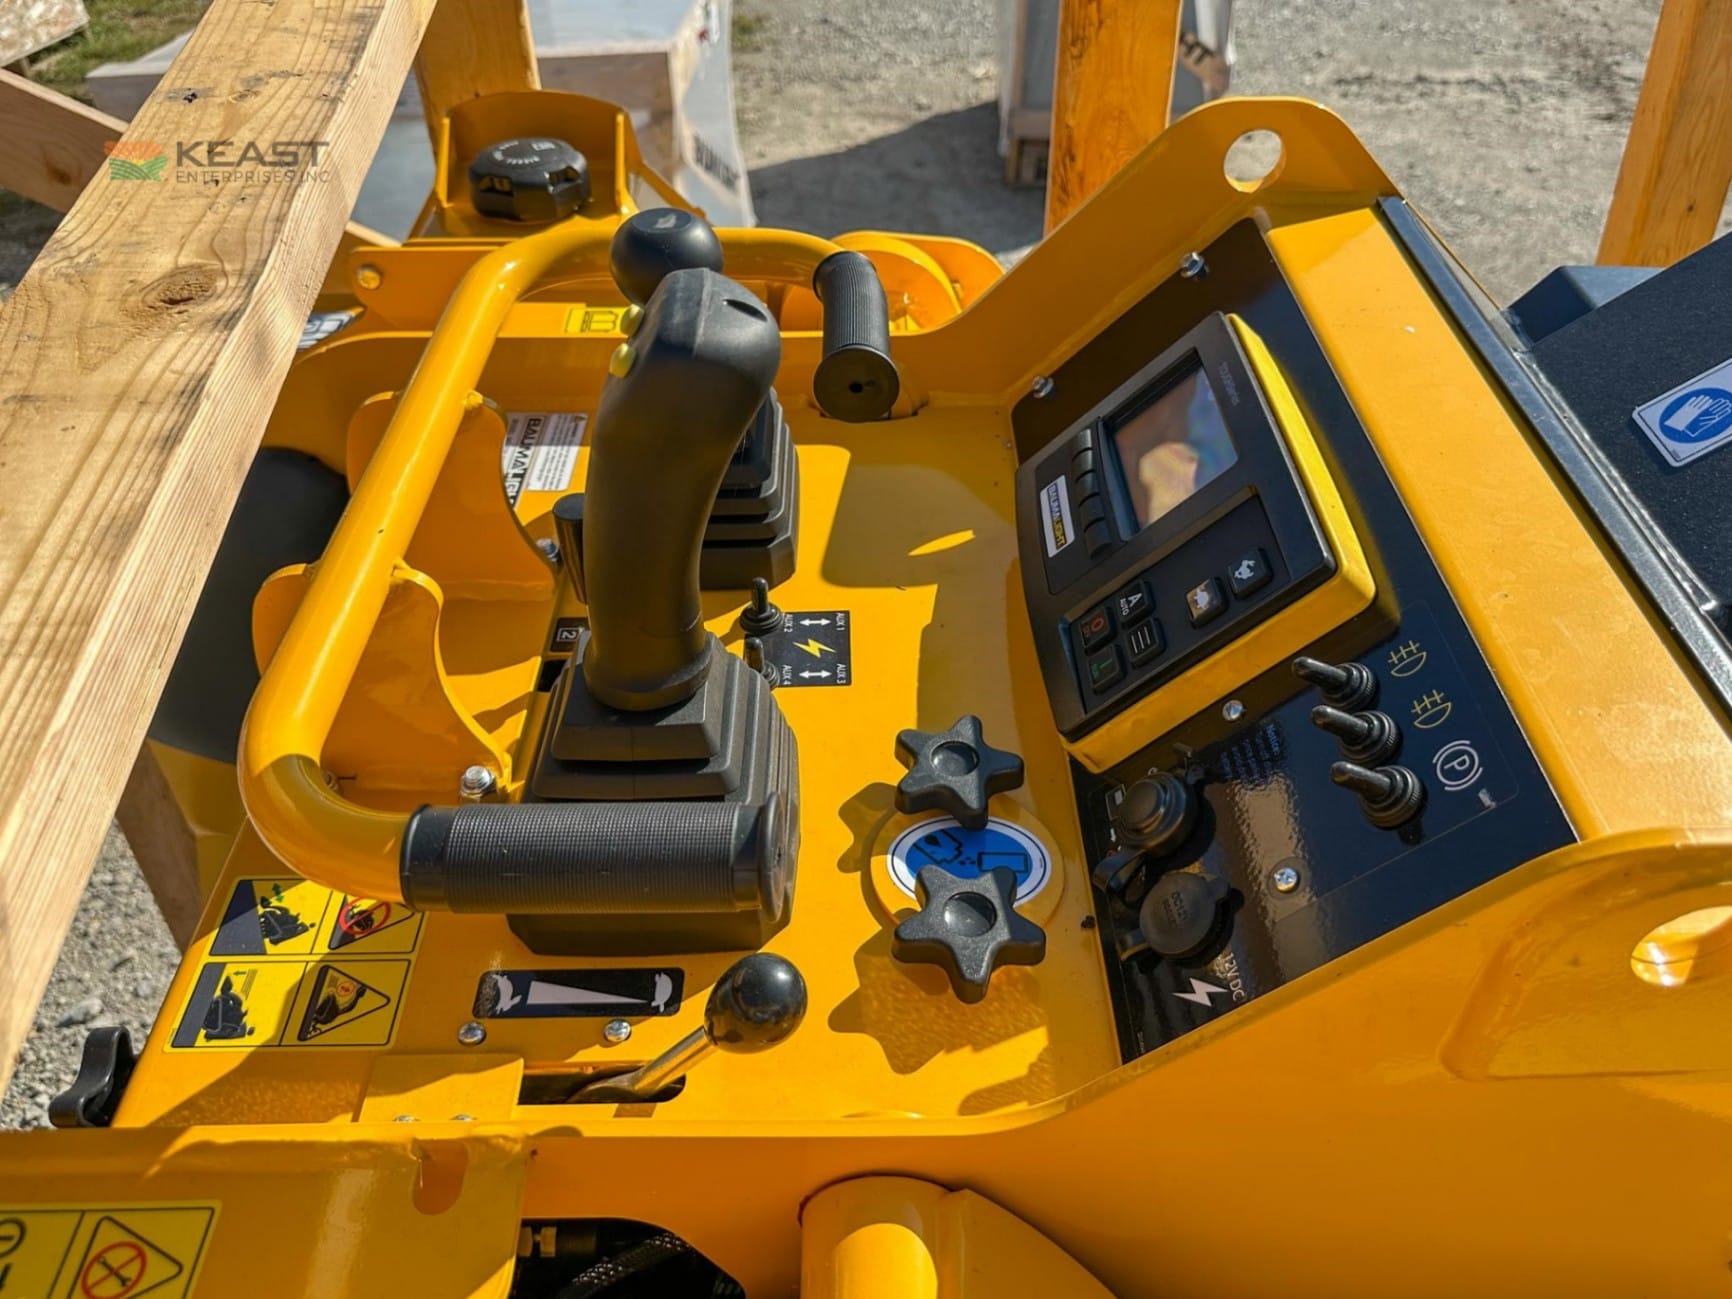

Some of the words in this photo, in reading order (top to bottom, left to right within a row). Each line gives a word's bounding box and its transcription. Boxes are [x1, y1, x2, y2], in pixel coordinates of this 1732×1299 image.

[503, 418, 542, 504] BAUMALIG
[1120, 598, 1130, 616] AUTO
[1127, 593, 1142, 607] A
[784, 614, 794, 627] AUX
[836, 612, 845, 626] AUX
[782, 664, 792, 680] AUX
[836, 664, 846, 678] AUX
[1223, 952, 1240, 977] 12V
[1229, 979, 1246, 1001] DC
